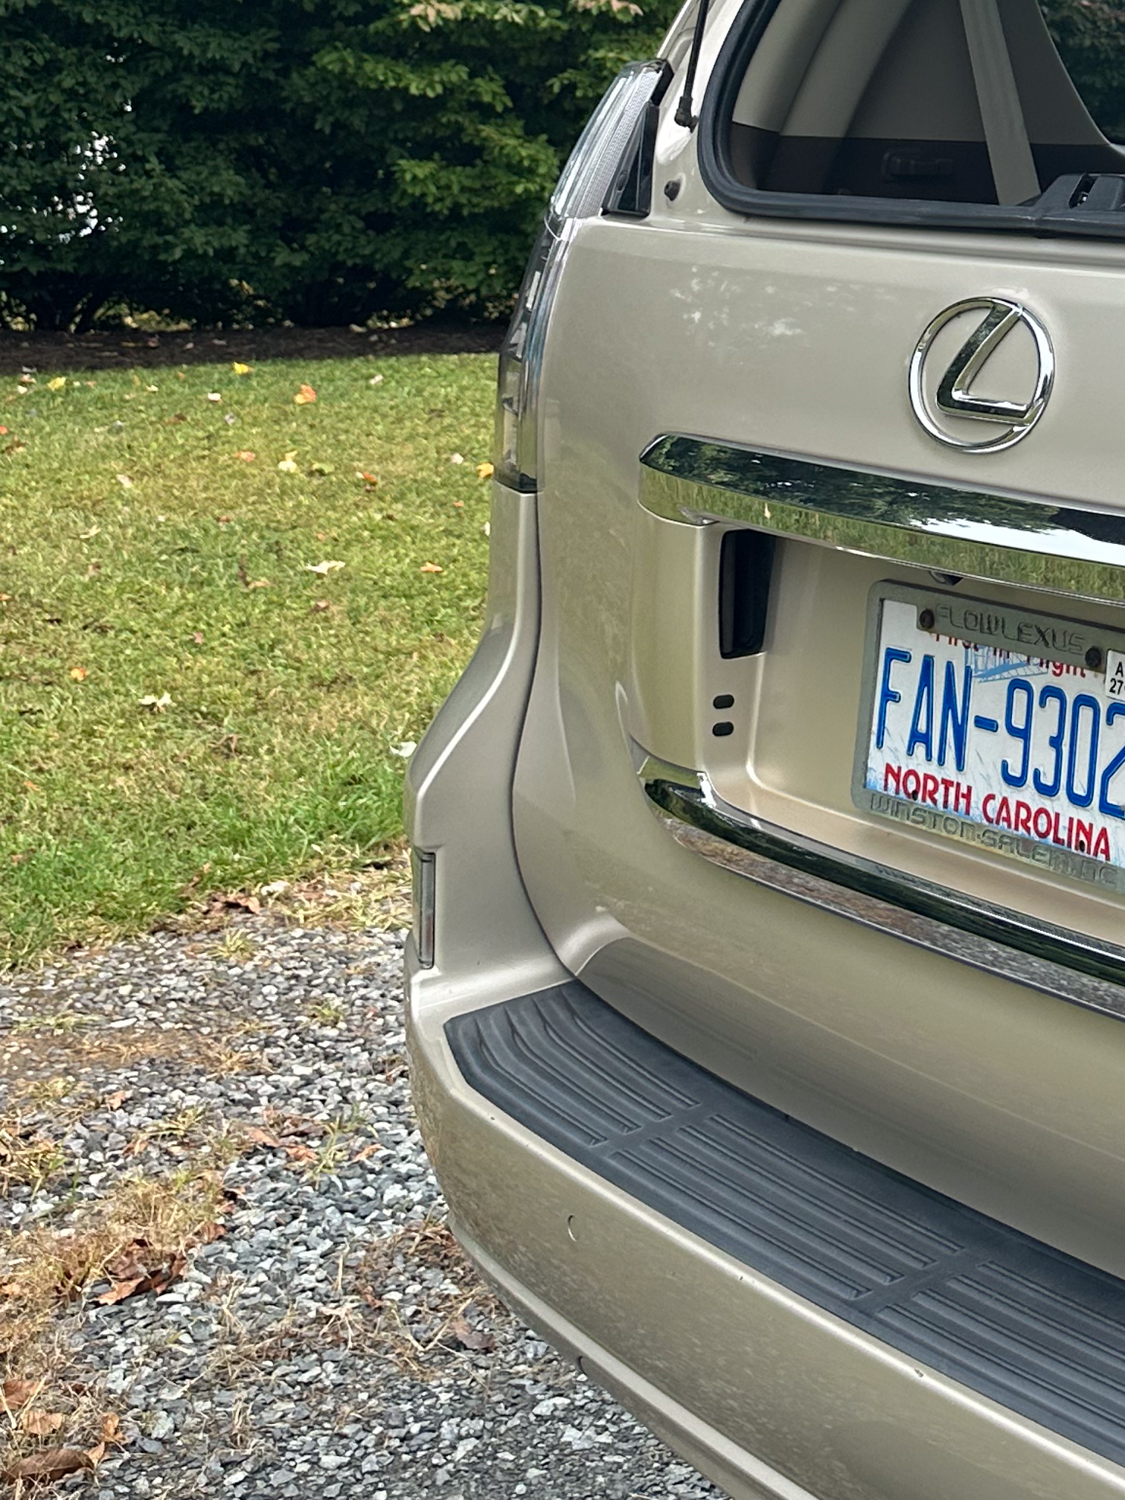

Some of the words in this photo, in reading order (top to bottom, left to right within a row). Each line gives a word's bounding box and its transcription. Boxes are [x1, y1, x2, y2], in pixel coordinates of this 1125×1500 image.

[1109, 677, 1124, 695] 27
[883, 763, 972, 816] NORTH
[982, 793, 1111, 861] CAROLINA
